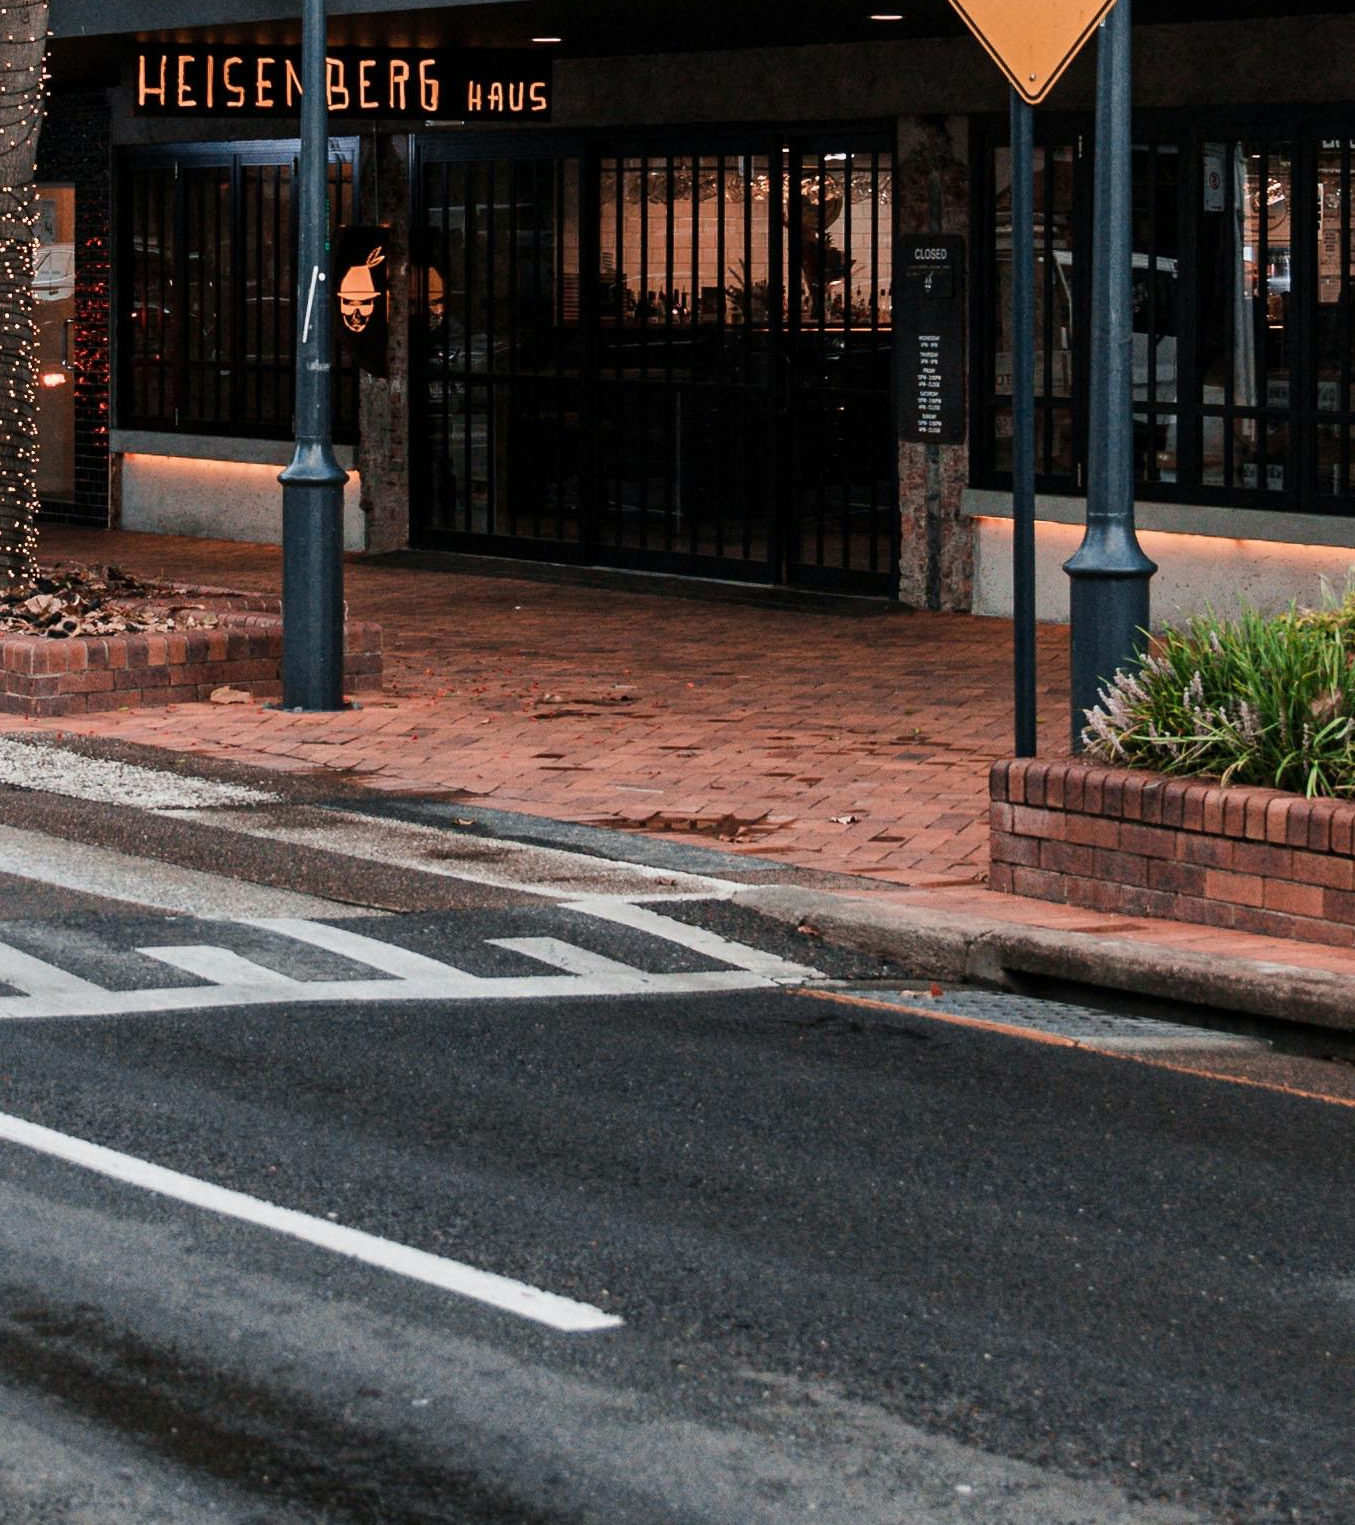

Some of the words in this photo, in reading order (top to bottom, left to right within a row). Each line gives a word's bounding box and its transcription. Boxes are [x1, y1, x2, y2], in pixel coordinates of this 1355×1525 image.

[138, 55, 439, 112] HEISENBERG
[468, 80, 547, 112] HAUS
[915, 248, 947, 260] CLOSED
